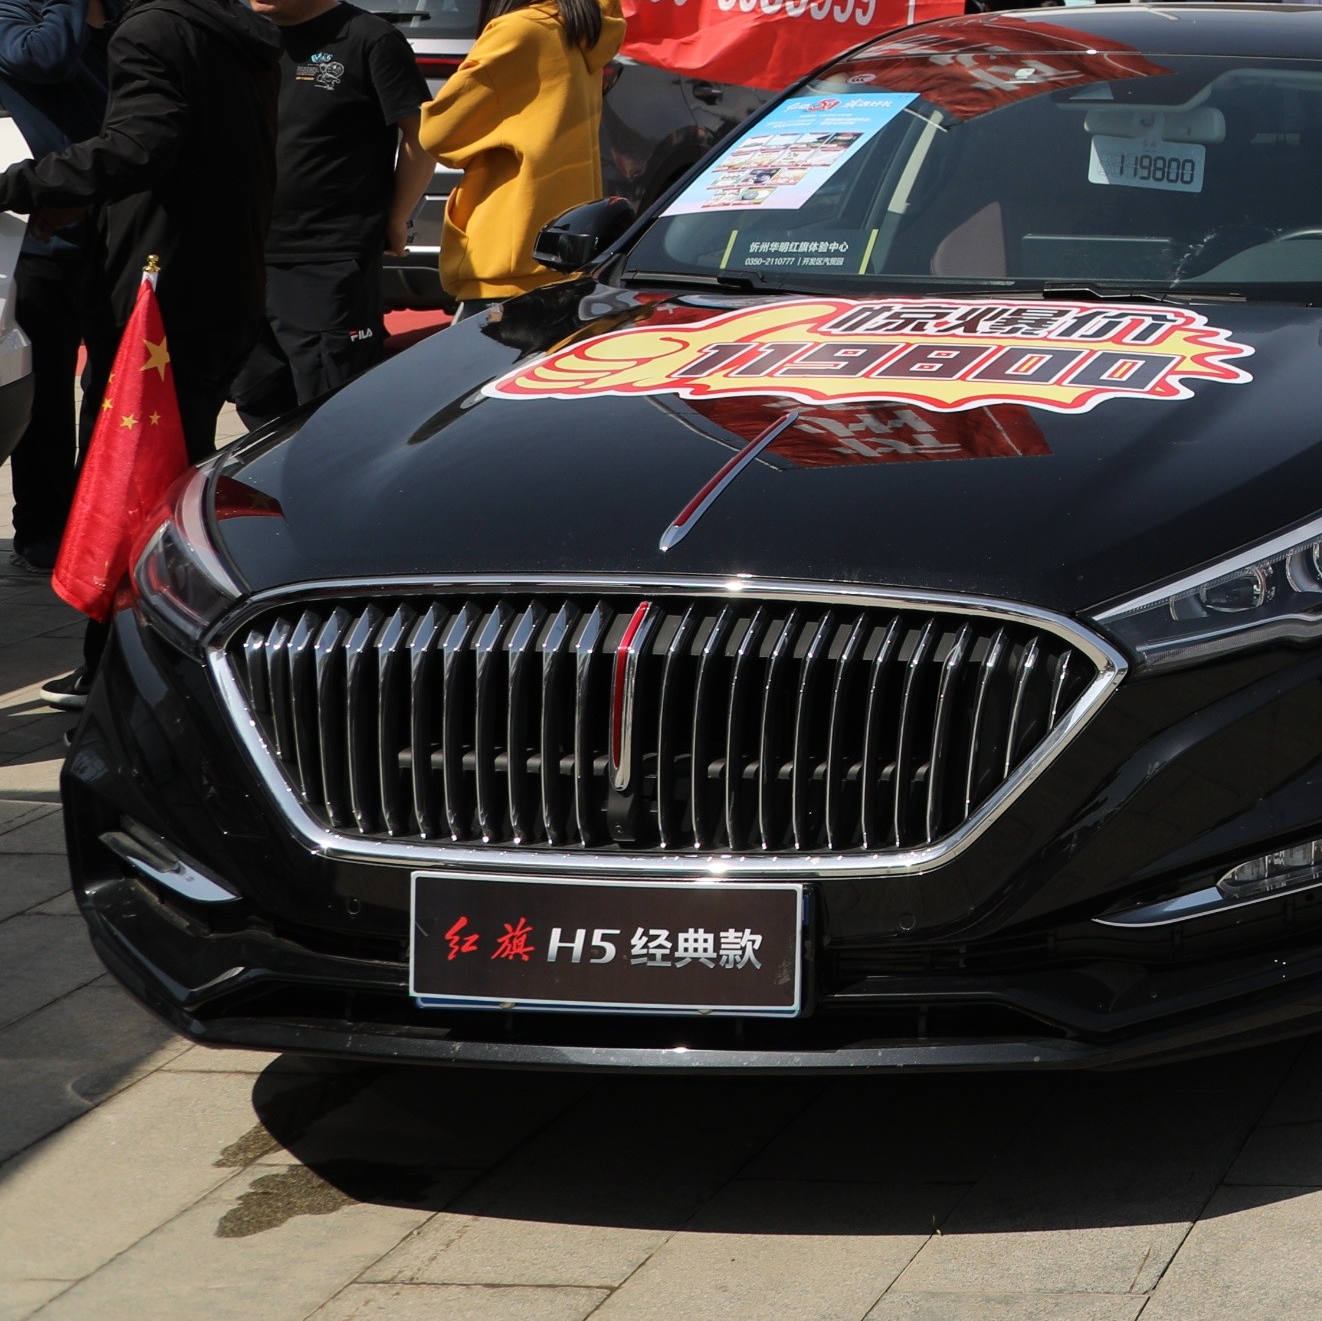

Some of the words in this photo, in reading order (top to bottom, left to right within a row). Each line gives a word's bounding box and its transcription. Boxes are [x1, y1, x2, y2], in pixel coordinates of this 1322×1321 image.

[1119, 154, 1195, 185] 119800
[745, 257, 795, 266] 0350-2110777
[749, 241, 849, 253] 忻州华明红旗体验中心
[349, 328, 373, 342] FILA
[832, 306, 1177, 342] 惊爆价
[670, 342, 1179, 389] 119800
[444, 916, 536, 962] 红旗
[547, 928, 621, 964] H5
[630, 927, 763, 970] 经典款
